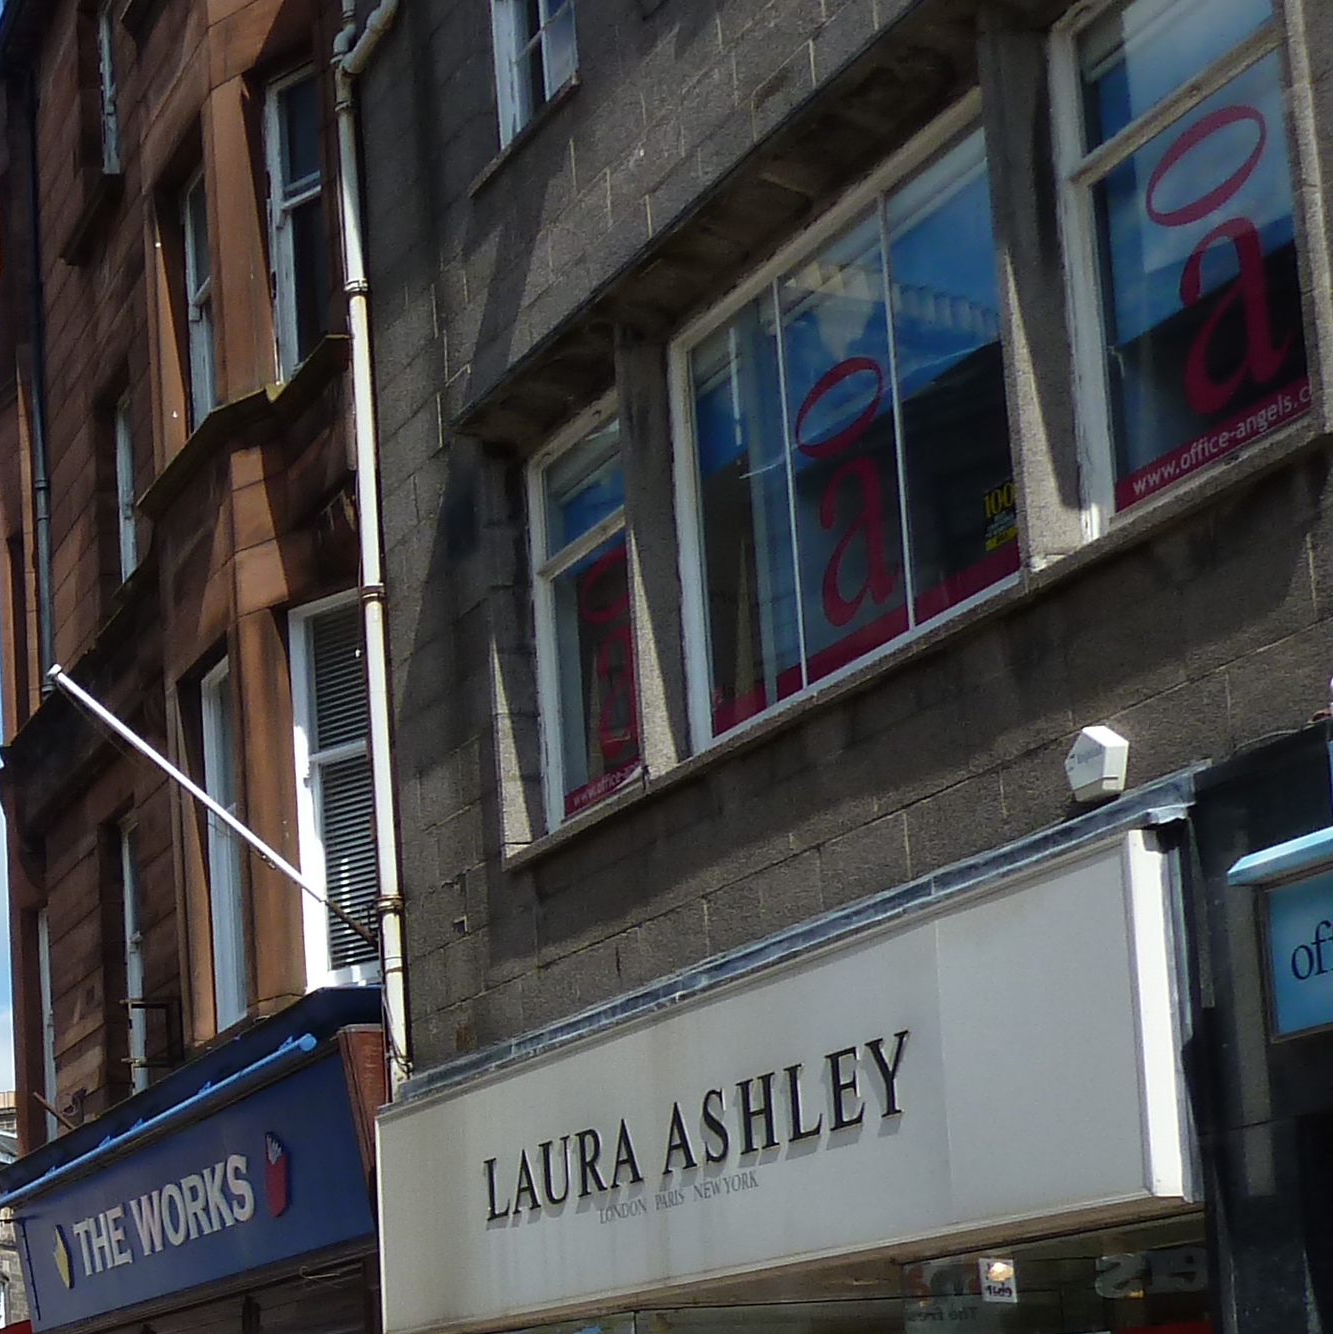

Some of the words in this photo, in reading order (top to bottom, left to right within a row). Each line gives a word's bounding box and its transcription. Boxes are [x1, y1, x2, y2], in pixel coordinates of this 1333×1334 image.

[1291, 919, 1333, 981] of
[482, 1118, 644, 1221] LAURA
[661, 1029, 911, 1174] ASHLEY
[73, 1206, 133, 1277] THE
[130, 1154, 256, 1257] WORKS
[598, 1198, 648, 1224] LONDON
[654, 1188, 685, 1211] PARIS
[693, 1178, 722, 1202] NEW
[724, 1170, 760, 1195] YORK
